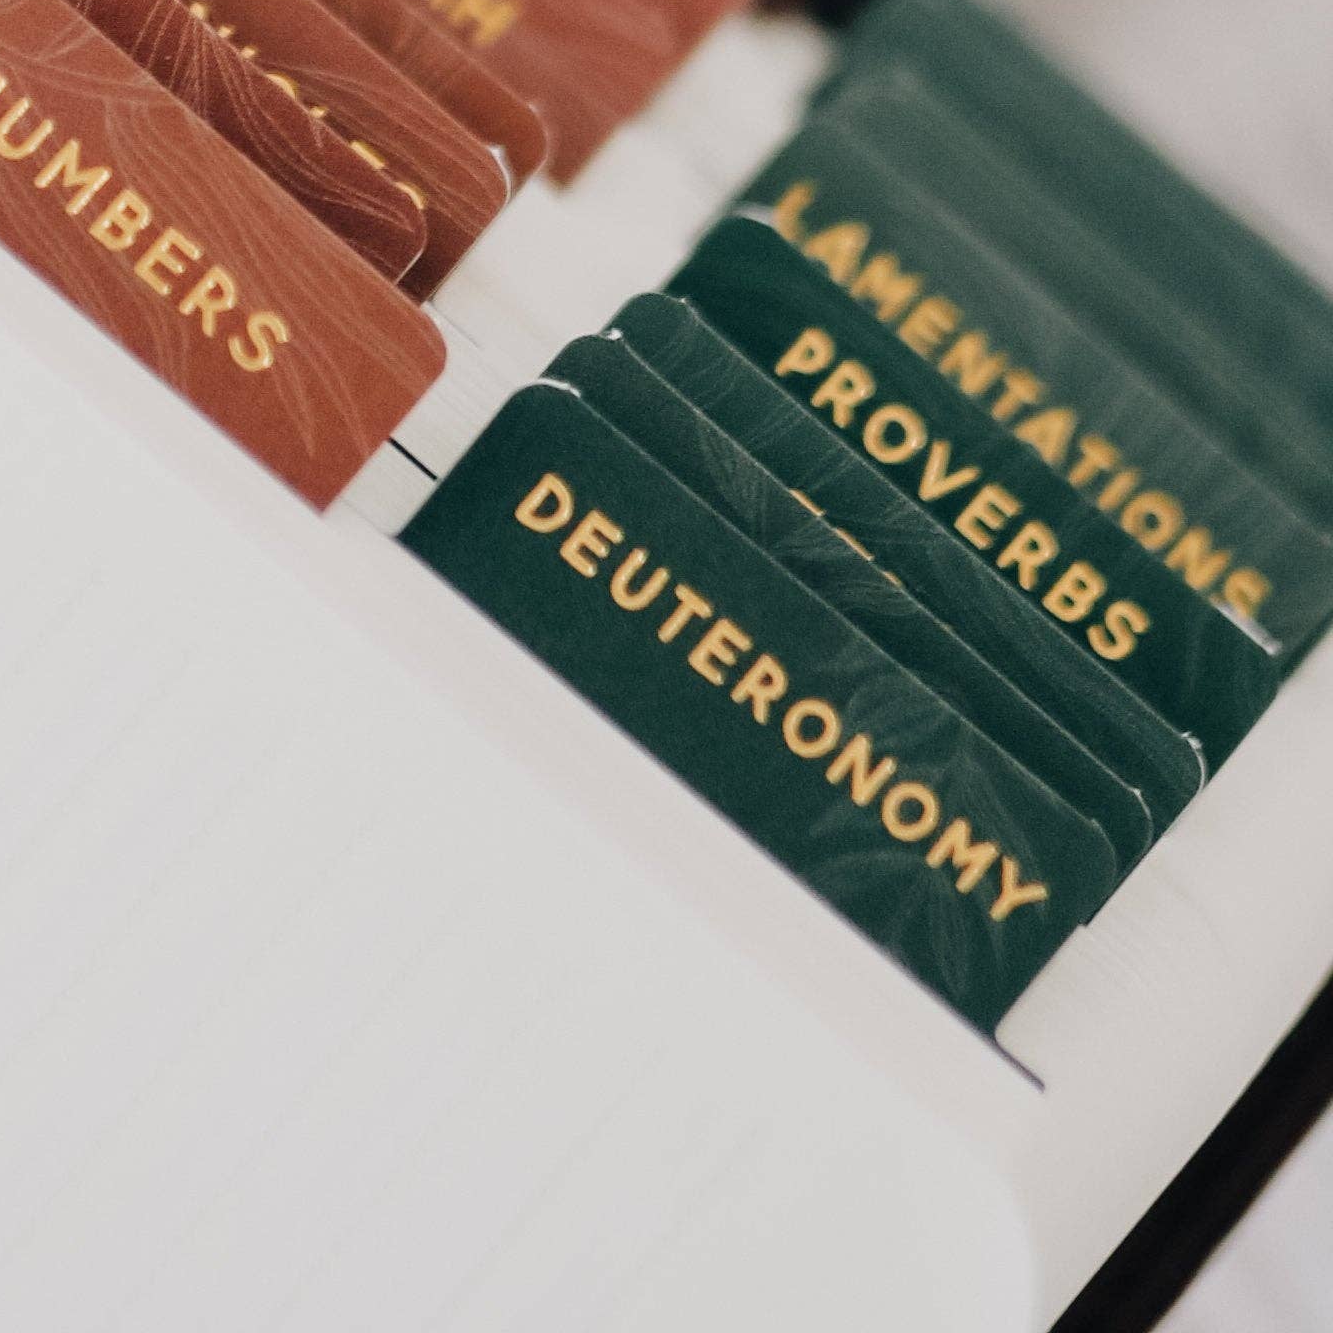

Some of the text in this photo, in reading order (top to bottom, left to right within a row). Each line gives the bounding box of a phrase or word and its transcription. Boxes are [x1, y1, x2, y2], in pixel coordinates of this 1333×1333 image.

[770, 179, 1277, 623] LAMENTATIONS
[774, 327, 1153, 664] PROVERBS
[513, 470, 1051, 926] DEUTERONOMY
